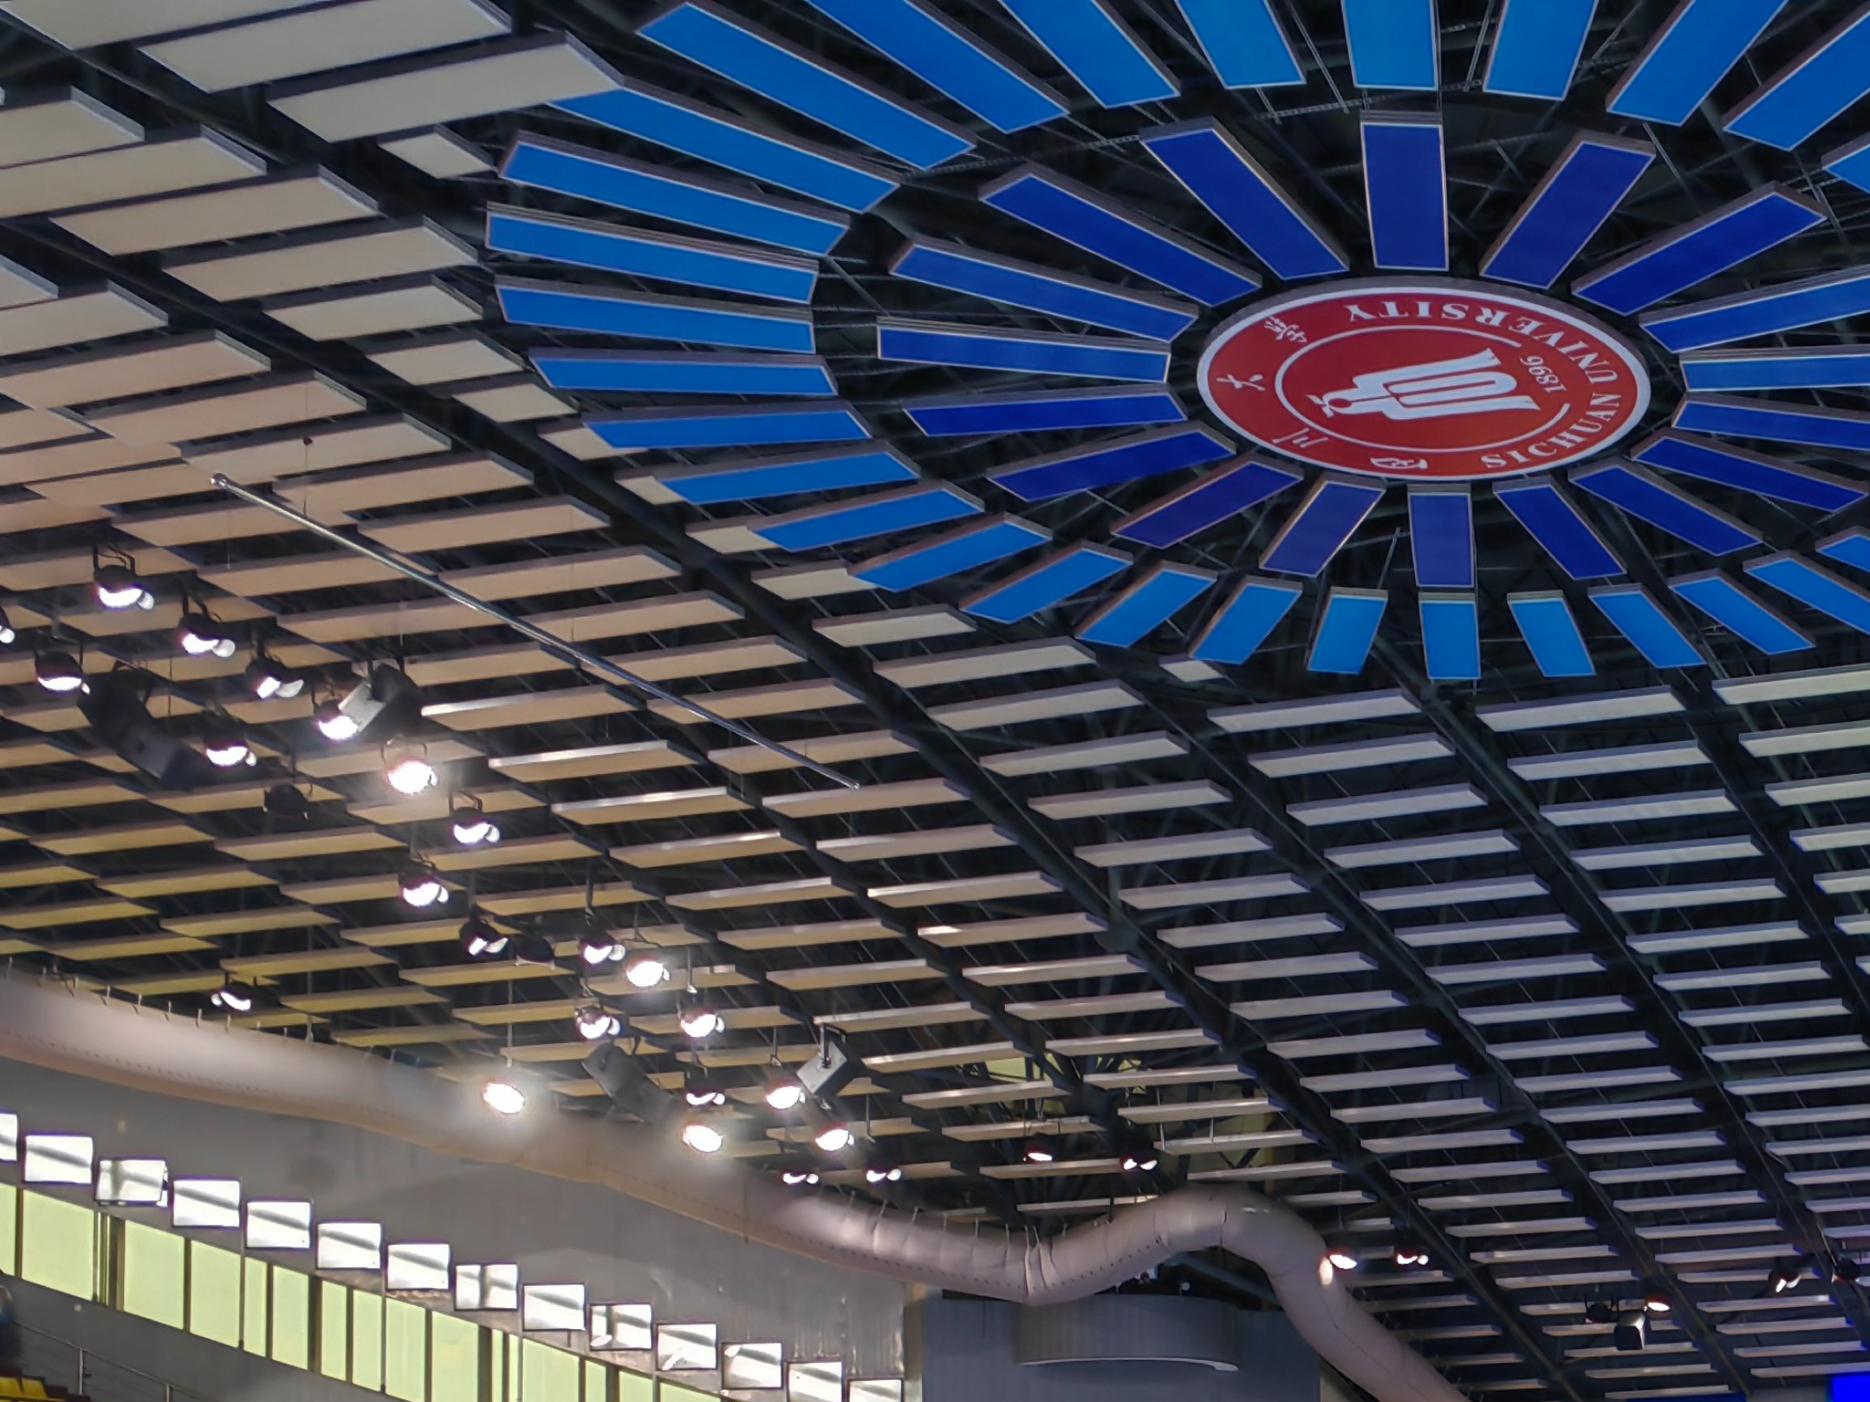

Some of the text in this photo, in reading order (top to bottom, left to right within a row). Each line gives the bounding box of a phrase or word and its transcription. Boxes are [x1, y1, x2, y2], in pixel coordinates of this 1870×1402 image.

[1346, 300, 1622, 468] SICHUAN UNIVERSITY
[1520, 355, 1567, 393] 1896
